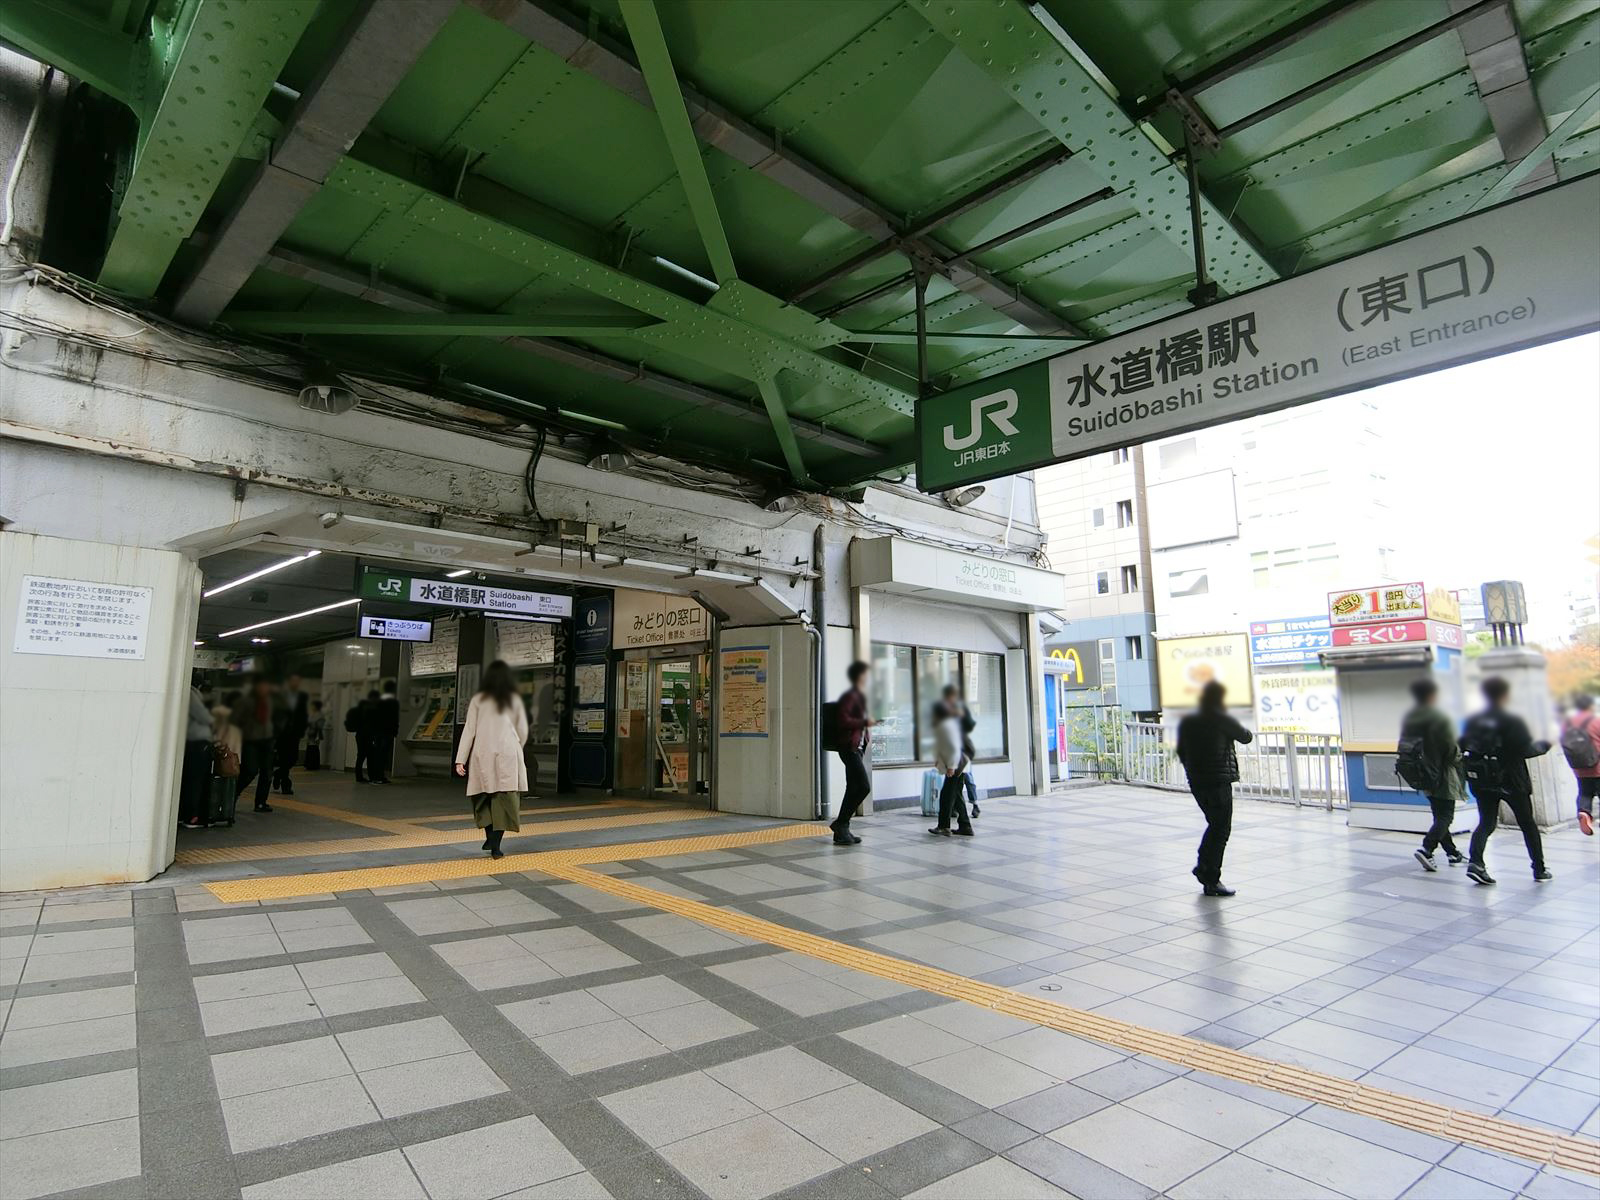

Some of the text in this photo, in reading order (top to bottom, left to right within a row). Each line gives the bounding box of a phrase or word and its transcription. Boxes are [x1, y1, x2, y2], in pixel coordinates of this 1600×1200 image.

[1065, 311, 1260, 409] 水道橋駅
[1066, 297, 1537, 438] Suidōbashi Station (East Entrance)
[943, 387, 1020, 452] JR
[953, 440, 1012, 467] JR東日本
[955, 576, 973, 587] Ticket
[974, 580, 990, 590] Office
[961, 560, 1016, 584] みどりの窓口
[378, 578, 402, 593] JR
[420, 583, 486, 605] 水道橋駅
[489, 590, 533, 602] Suidōbashi
[489, 601, 517, 609] Station
[1332, 592, 1361, 616] 大当り
[1365, 591, 1381, 614] 1
[632, 607, 701, 631] みどりの窓口
[627, 634, 645, 645] Ticket
[645, 632, 664, 643] Office
[1349, 625, 1408, 645] 宝くじ
[1435, 626, 1458, 644] 宝くじ
